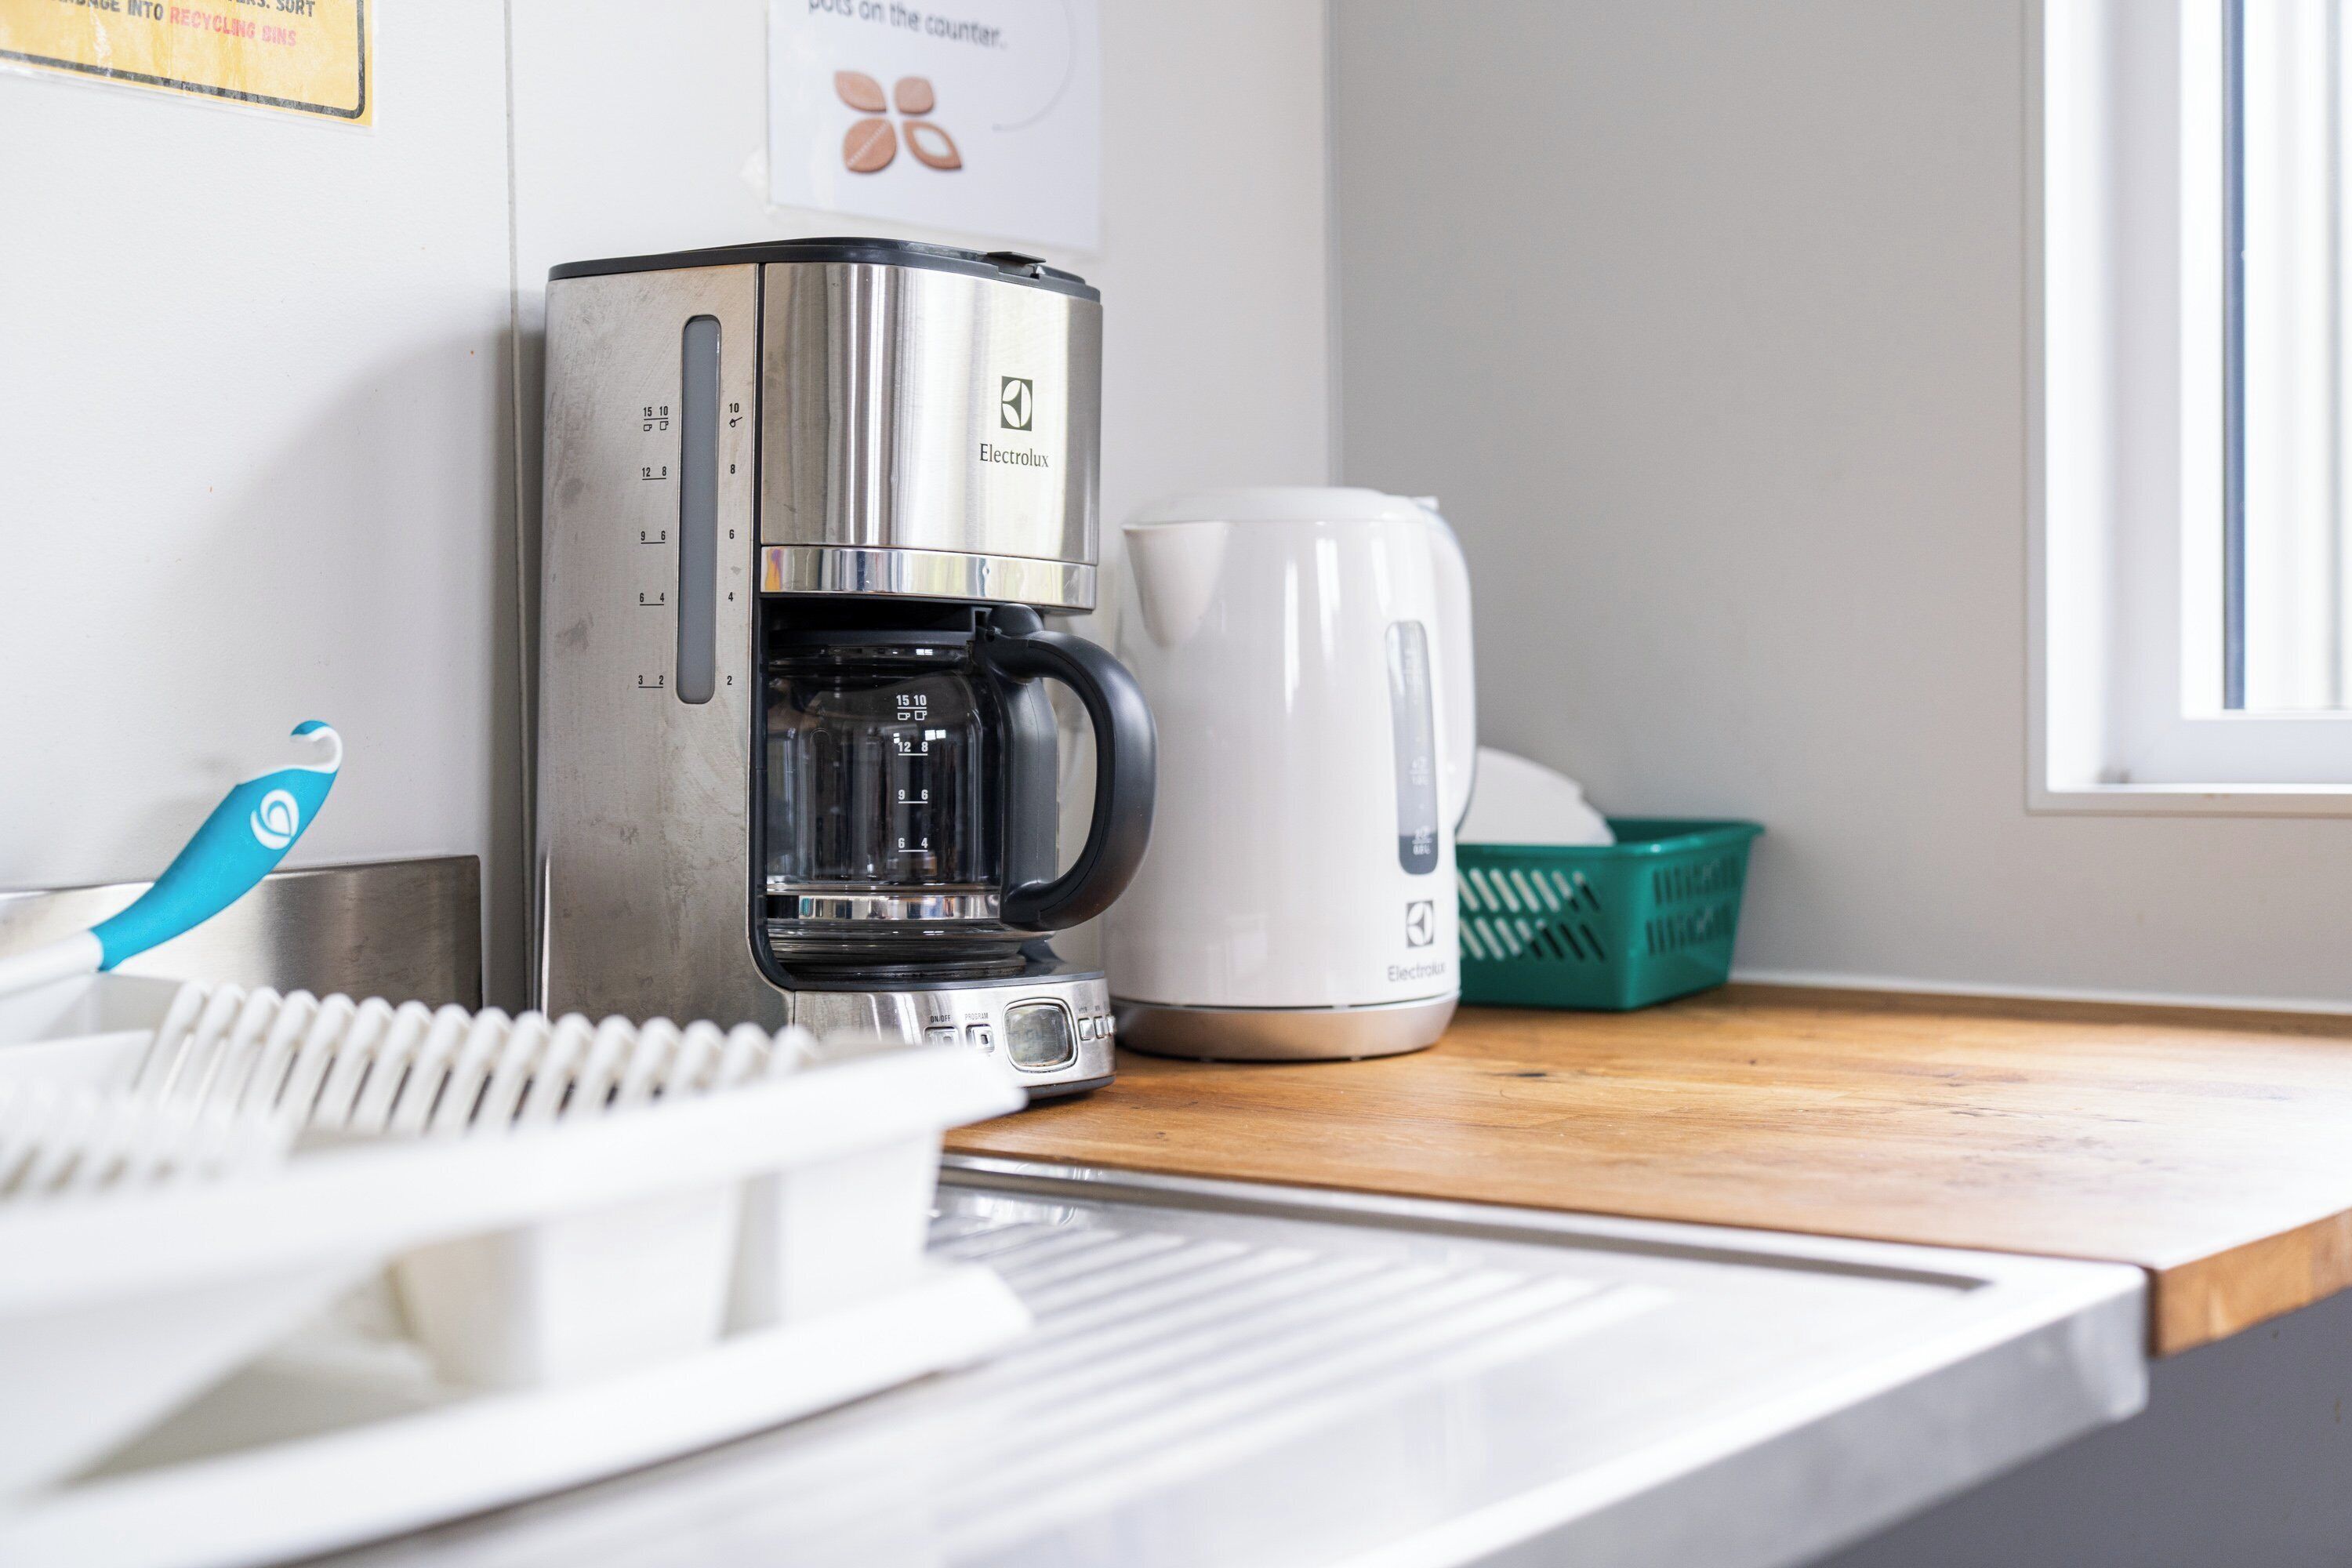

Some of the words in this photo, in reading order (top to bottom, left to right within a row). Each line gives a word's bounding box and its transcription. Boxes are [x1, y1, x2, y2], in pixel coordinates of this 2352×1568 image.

[276, 0, 315, 17] SORT
[858, 1, 884, 23] on
[889, 2, 920, 31] the
[128, 0, 164, 20] INTO
[169, 6, 256, 39] RECYCLING
[262, 25, 296, 46] BINS
[643, 406, 652, 417] 15
[659, 405, 669, 416] 10
[729, 402, 739, 413] 10
[979, 443, 1049, 468] Electrolux
[641, 466, 651, 477] 12
[662, 466, 667, 477] 8
[730, 463, 735, 474] 8
[641, 531, 645, 541] 9
[661, 530, 666, 541] 6
[729, 529, 735, 539] 6
[639, 593, 644, 603] 6
[659, 592, 665, 602] 4
[728, 592, 734, 602] 4
[638, 675, 643, 685] 3
[659, 675, 664, 685] 2
[727, 676, 732, 686] 2
[896, 695, 909, 706] 15
[913, 695, 927, 706] 10
[898, 742, 911, 753] 12
[921, 742, 928, 753] 8
[898, 789, 906, 800] 9
[921, 789, 928, 800] 6
[898, 837, 905, 848] 6
[920, 837, 928, 848] 4
[1387, 961, 1445, 982] Electrolux
[930, 1014, 951, 1024] ON/OFF
[964, 1012, 989, 1022] PROGRAM
